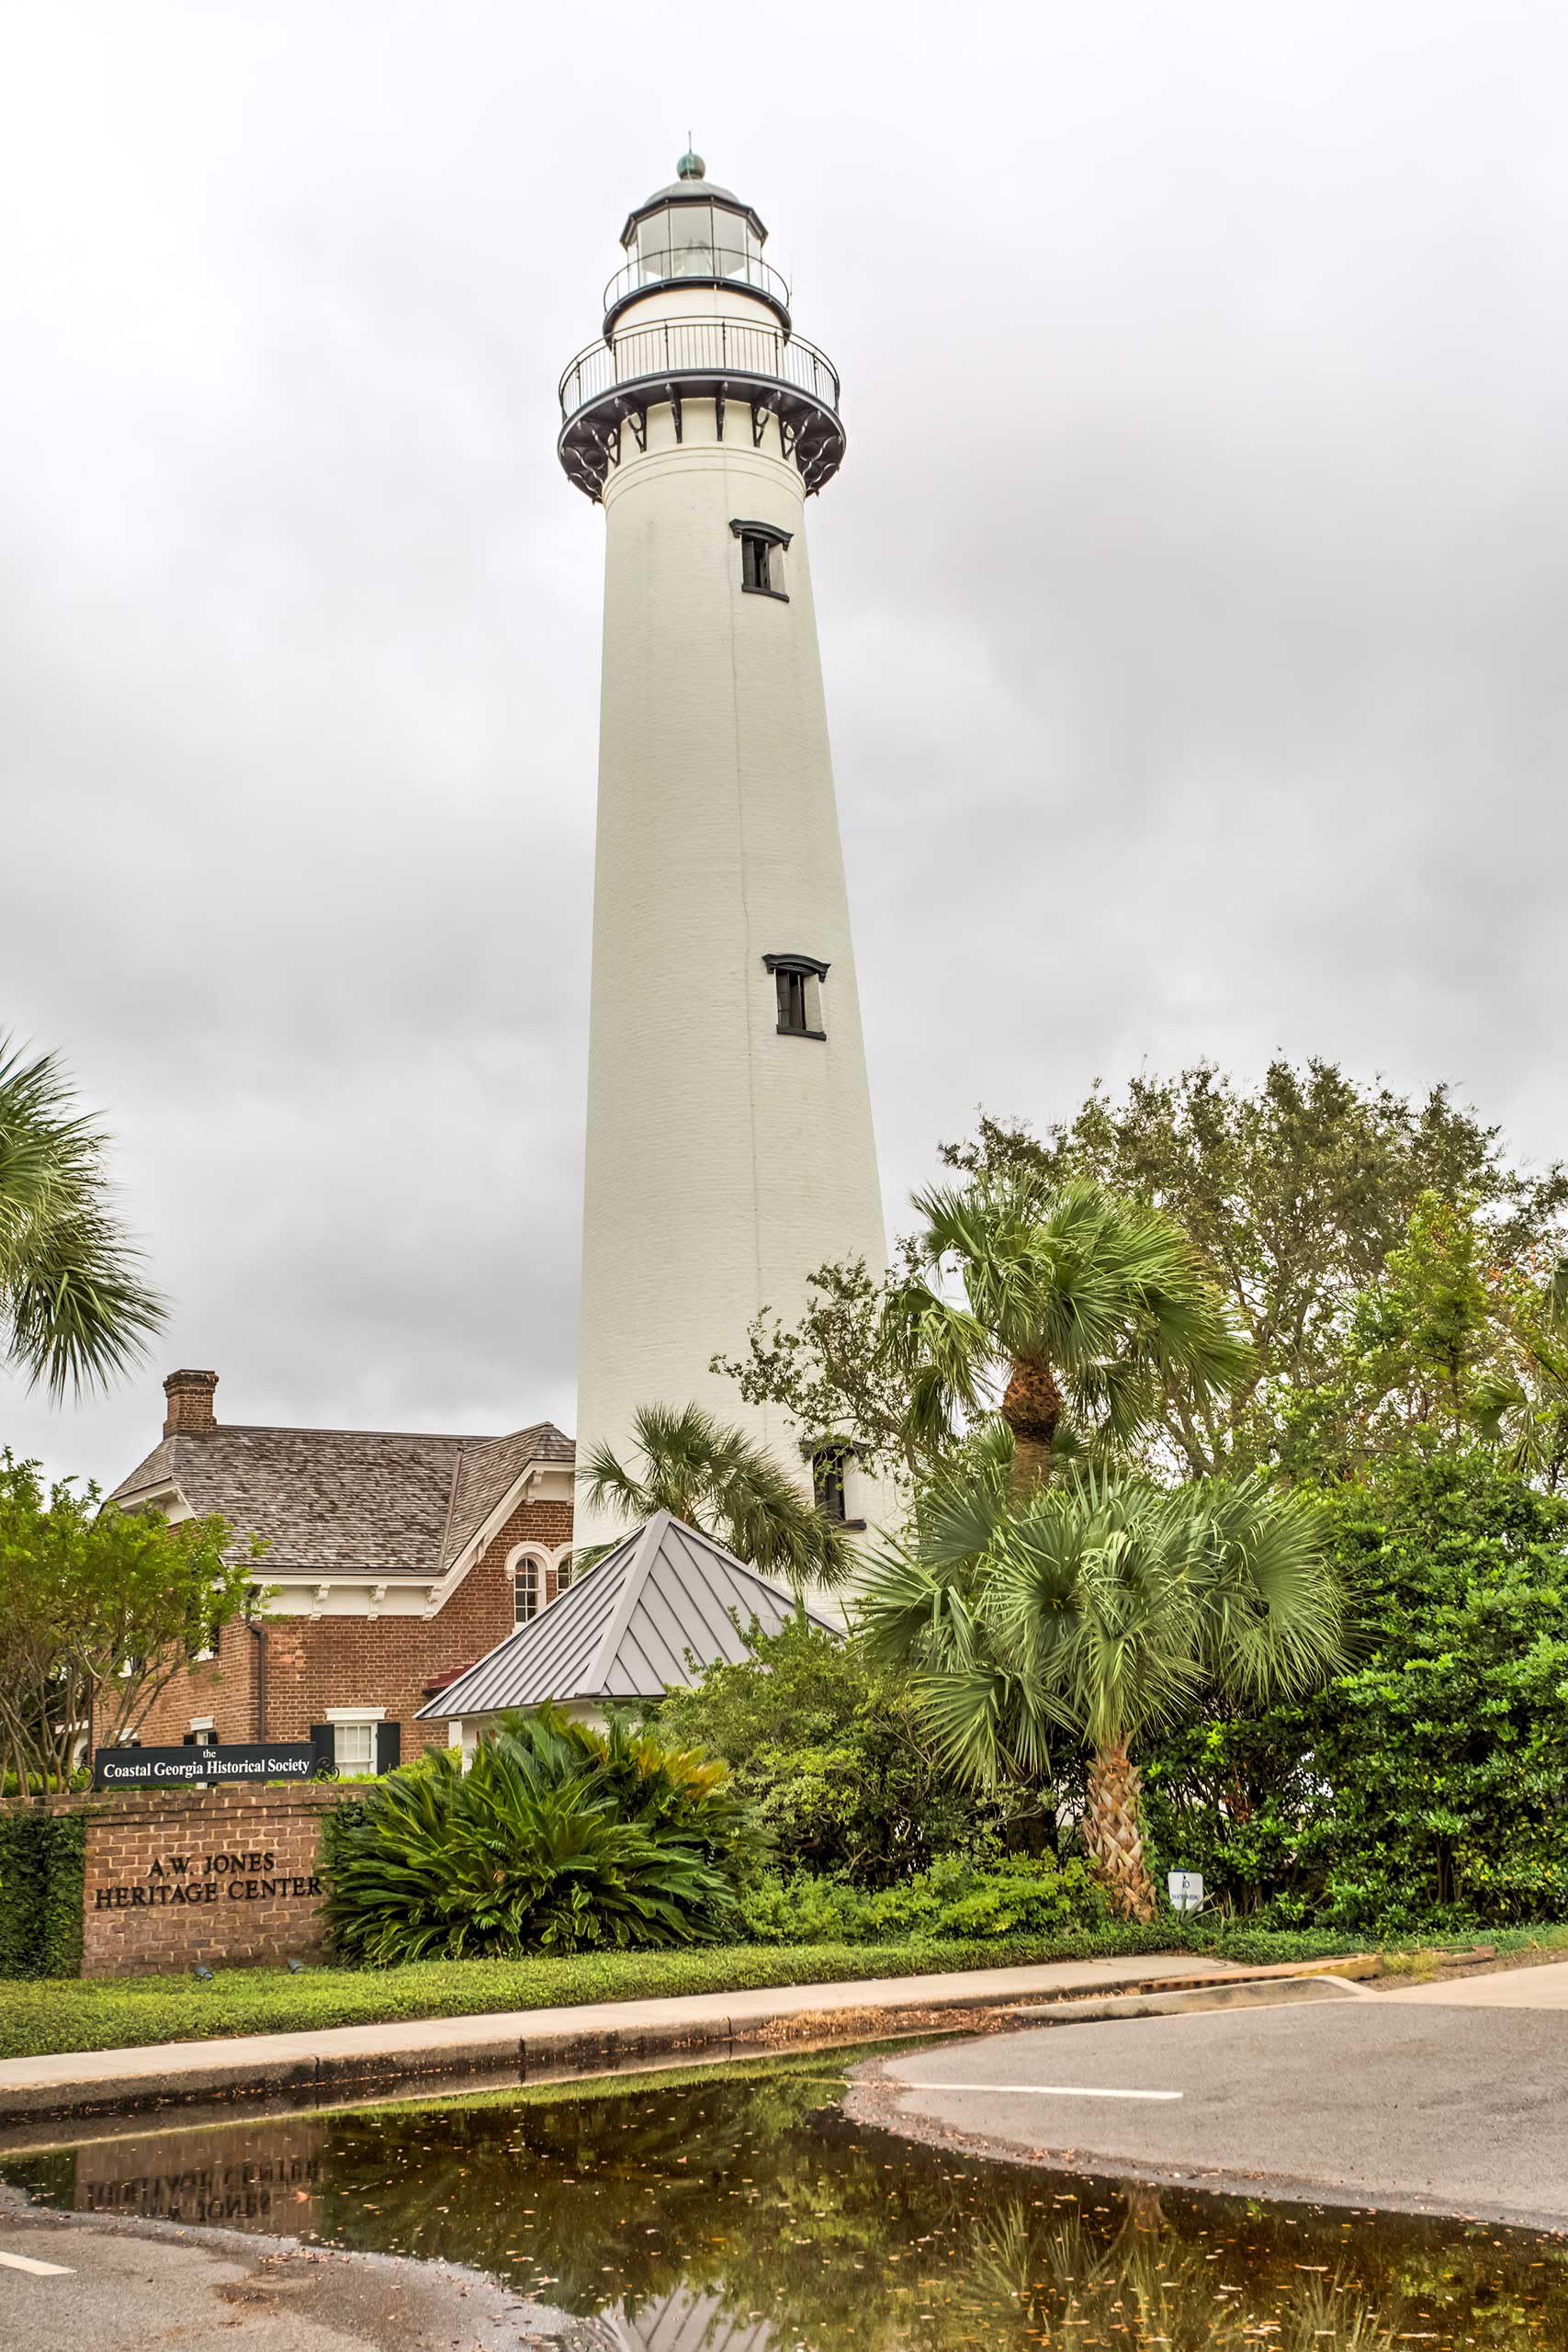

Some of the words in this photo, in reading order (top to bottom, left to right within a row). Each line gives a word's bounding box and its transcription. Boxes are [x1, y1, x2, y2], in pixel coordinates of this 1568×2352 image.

[203, 1748, 217, 1758] the
[103, 1763, 152, 1778] Coastal
[153, 1761, 204, 1779] Georgia
[207, 1759, 265, 1774] Historical
[267, 1758, 310, 1775] Society
[147, 1856, 194, 1877] A.W.
[203, 1851, 275, 1875] JONES
[95, 1882, 219, 1908] HERITAGE
[228, 1876, 322, 1900] CENTER
